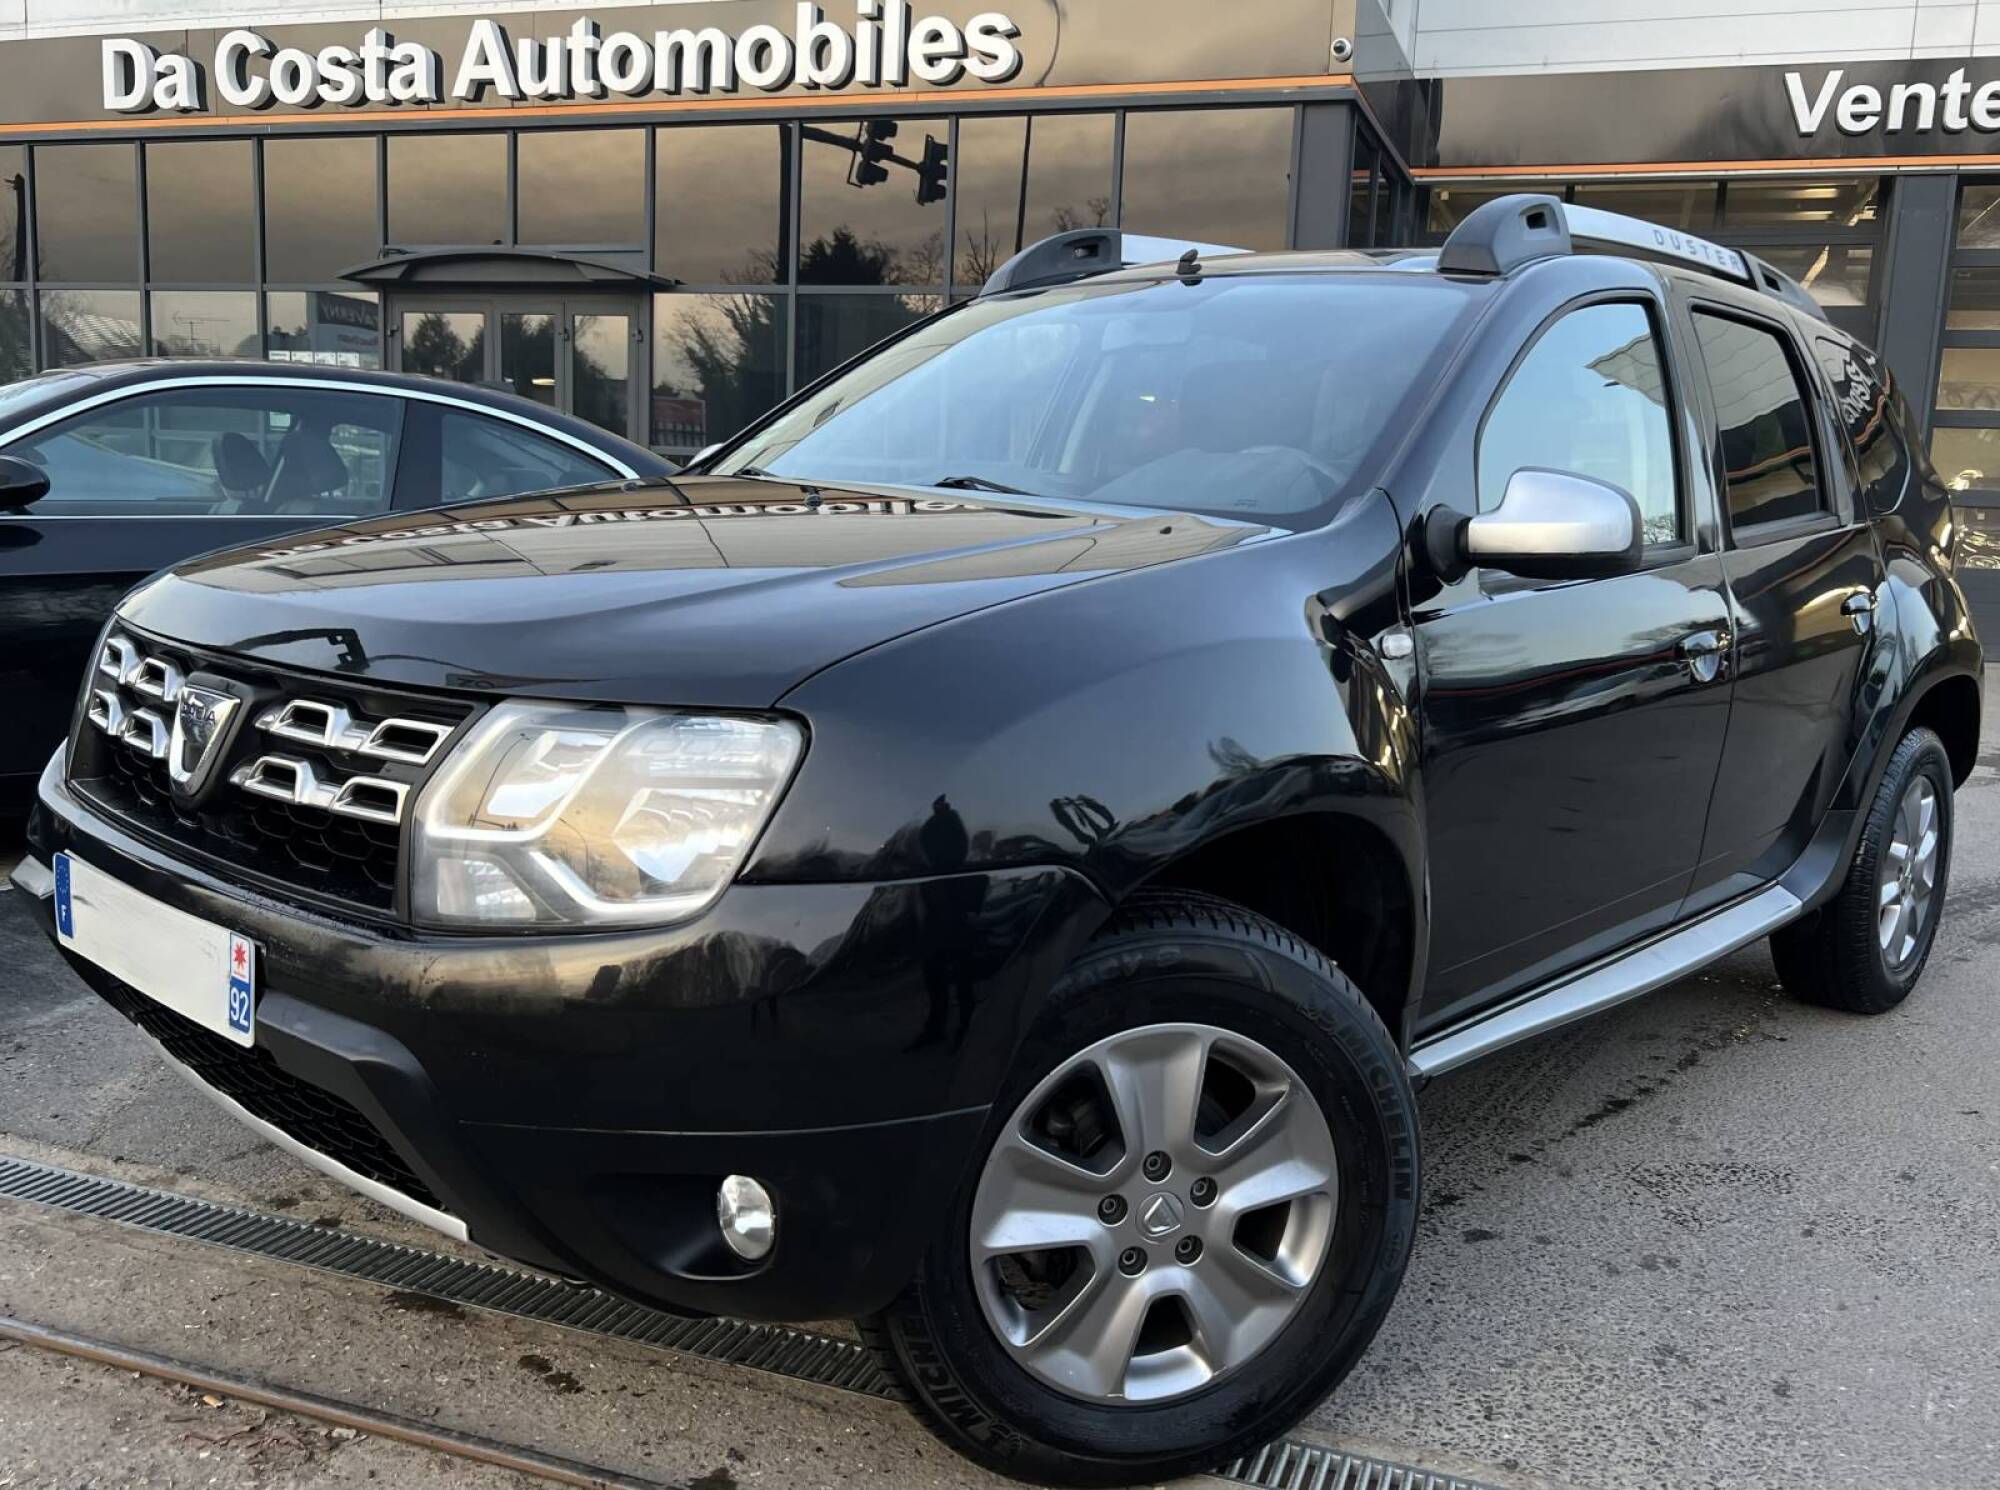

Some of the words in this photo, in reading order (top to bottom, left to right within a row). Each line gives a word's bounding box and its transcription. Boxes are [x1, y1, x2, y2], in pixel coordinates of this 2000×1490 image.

[102, 37, 201, 112] Da
[214, 27, 438, 107] Costa
[452, 0, 1022, 99] Automobiles
[1784, 67, 2000, 137] Vente
[1652, 229, 1743, 273] DUSTER
[61, 904, 67, 922] F
[230, 987, 249, 1027] 92
[1338, 1025, 1412, 1201] MICHELIN
